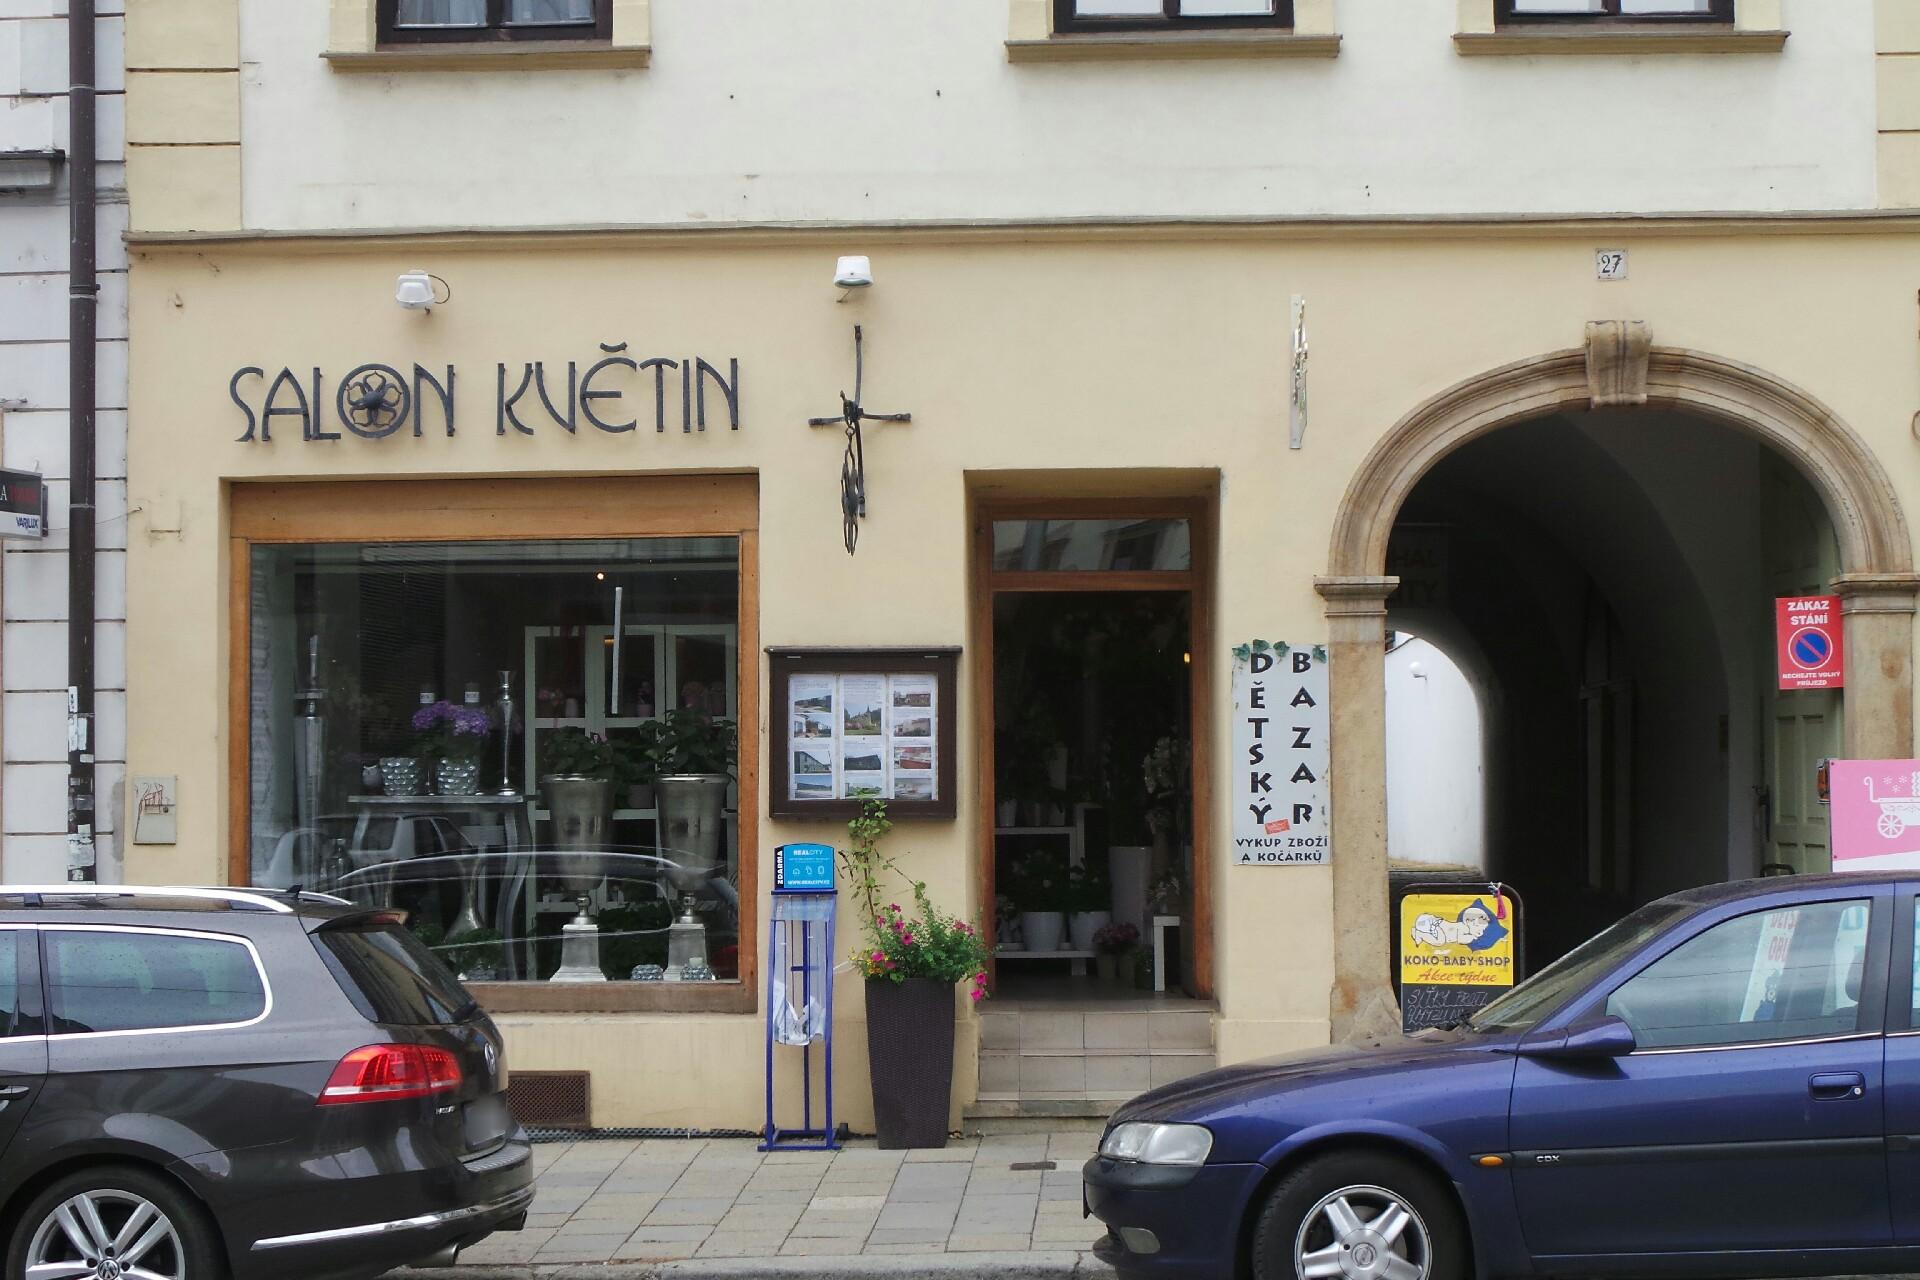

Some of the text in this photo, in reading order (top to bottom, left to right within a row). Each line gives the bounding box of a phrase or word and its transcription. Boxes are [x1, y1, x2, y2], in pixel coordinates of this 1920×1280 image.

[1601, 254, 1622, 273] 27
[229, 342, 739, 442] SALON KVĚTIN
[1787, 600, 1830, 611] ZÁKAZ
[1790, 612, 1828, 625] STÁNÍ
[1247, 652, 1273, 825] DĚTSKÝ
[1290, 652, 1316, 825] BAZAR
[1236, 835, 1328, 848] VYKUP ZBOŽÍ
[1241, 852, 1251, 861] A
[1416, 967, 1498, 985] Akce týdne
[1536, 1155, 1560, 1163] CDX
